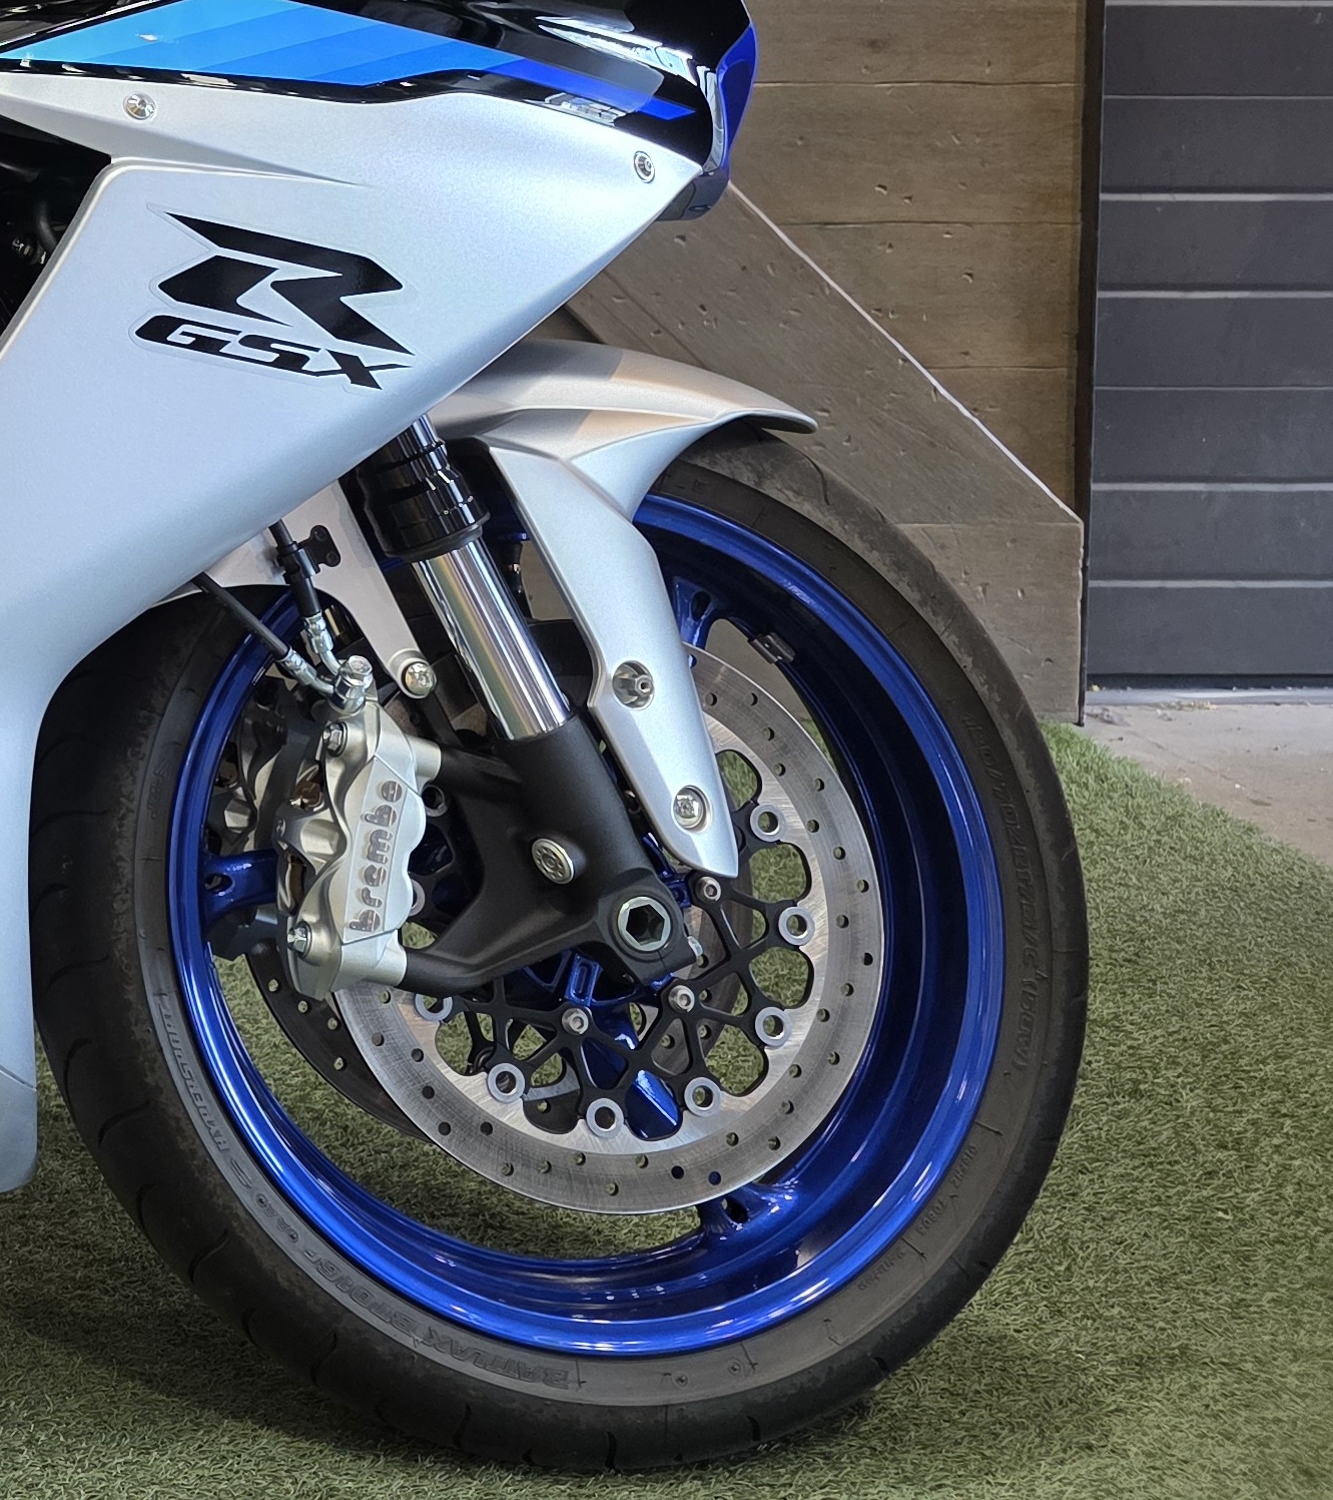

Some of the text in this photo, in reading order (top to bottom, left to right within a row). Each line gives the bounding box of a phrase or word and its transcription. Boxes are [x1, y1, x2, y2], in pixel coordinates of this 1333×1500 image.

[158, 211, 416, 356] R
[135, 315, 413, 390] GSX
[350, 779, 402, 933] brembo
[421, 1325, 569, 1390] BATTLAX
